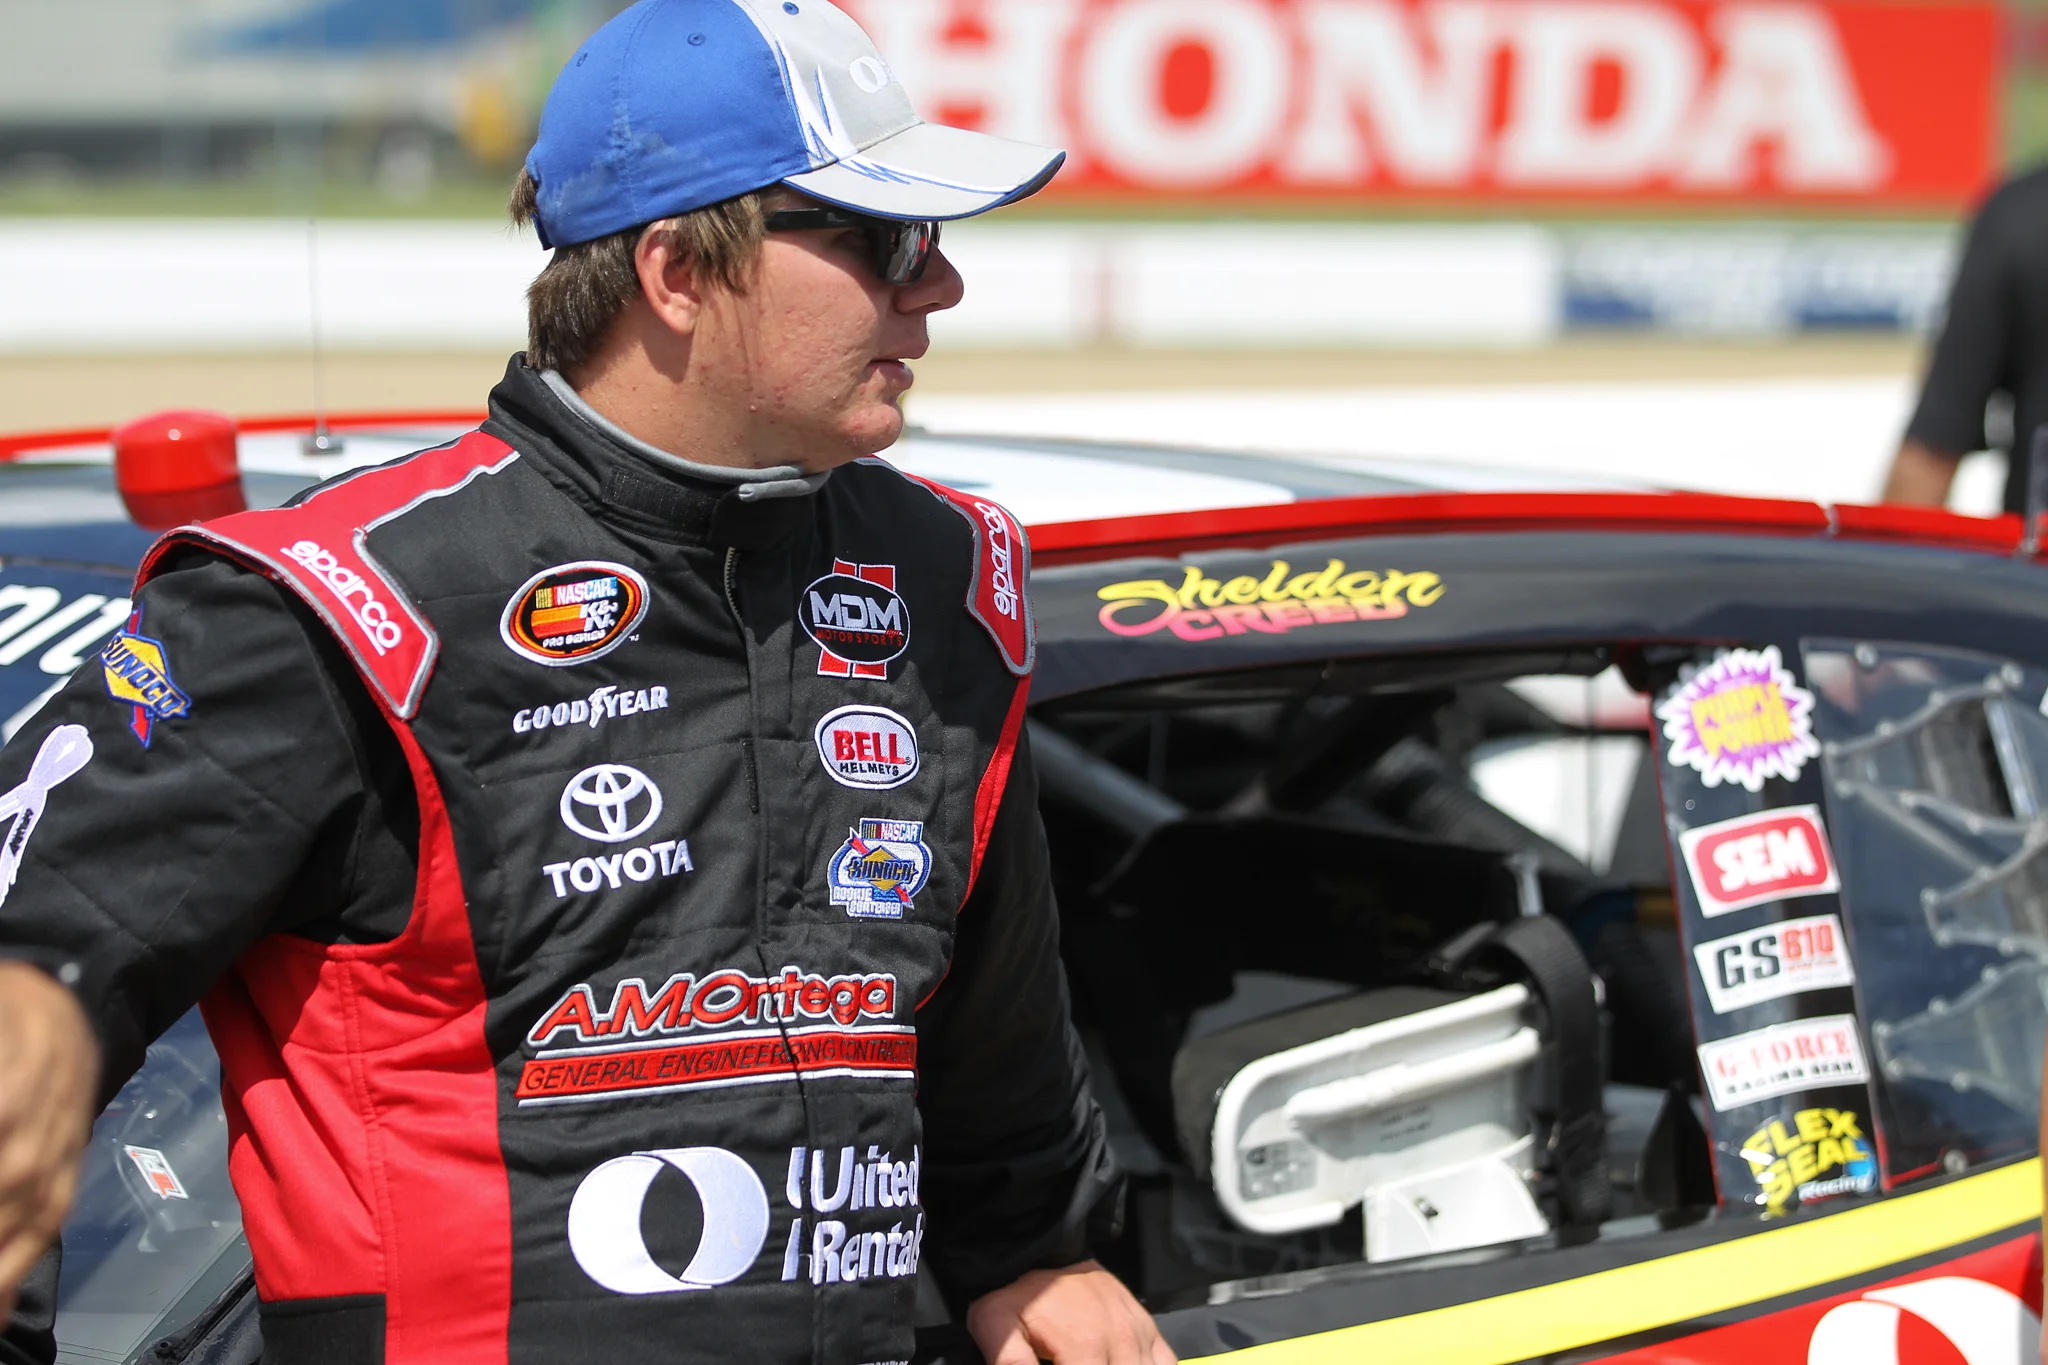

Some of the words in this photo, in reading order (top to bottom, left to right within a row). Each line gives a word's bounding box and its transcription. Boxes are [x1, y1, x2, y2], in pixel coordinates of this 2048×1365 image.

[884, 0, 1890, 192] HONDA
[974, 502, 1018, 621] sparco
[282, 540, 402, 655] sparco
[556, 578, 615, 606] NASCAR
[809, 590, 902, 631] MDM
[1097, 558, 1446, 636] Sheldon
[542, 636, 565, 648] PRO
[565, 629, 606, 645] SERIES
[815, 629, 903, 647] MOTORSPORTS
[1169, 596, 1408, 642] CREED
[100, 633, 183, 717] SUNOCO
[833, 729, 908, 765] BELL
[839, 762, 899, 776] HELMETS
[881, 823, 919, 842] NASCAR
[542, 839, 694, 898] TOYOTA
[850, 860, 914, 881] SUNOCO
[1712, 826, 1819, 893] SEM
[525, 1057, 650, 1092] GENERAL
[1715, 1029, 1852, 1079] G-FORCE
[1743, 1107, 1862, 1176] FLEX
[786, 1144, 919, 1213] United
[1761, 1135, 1870, 1209] SEAL
